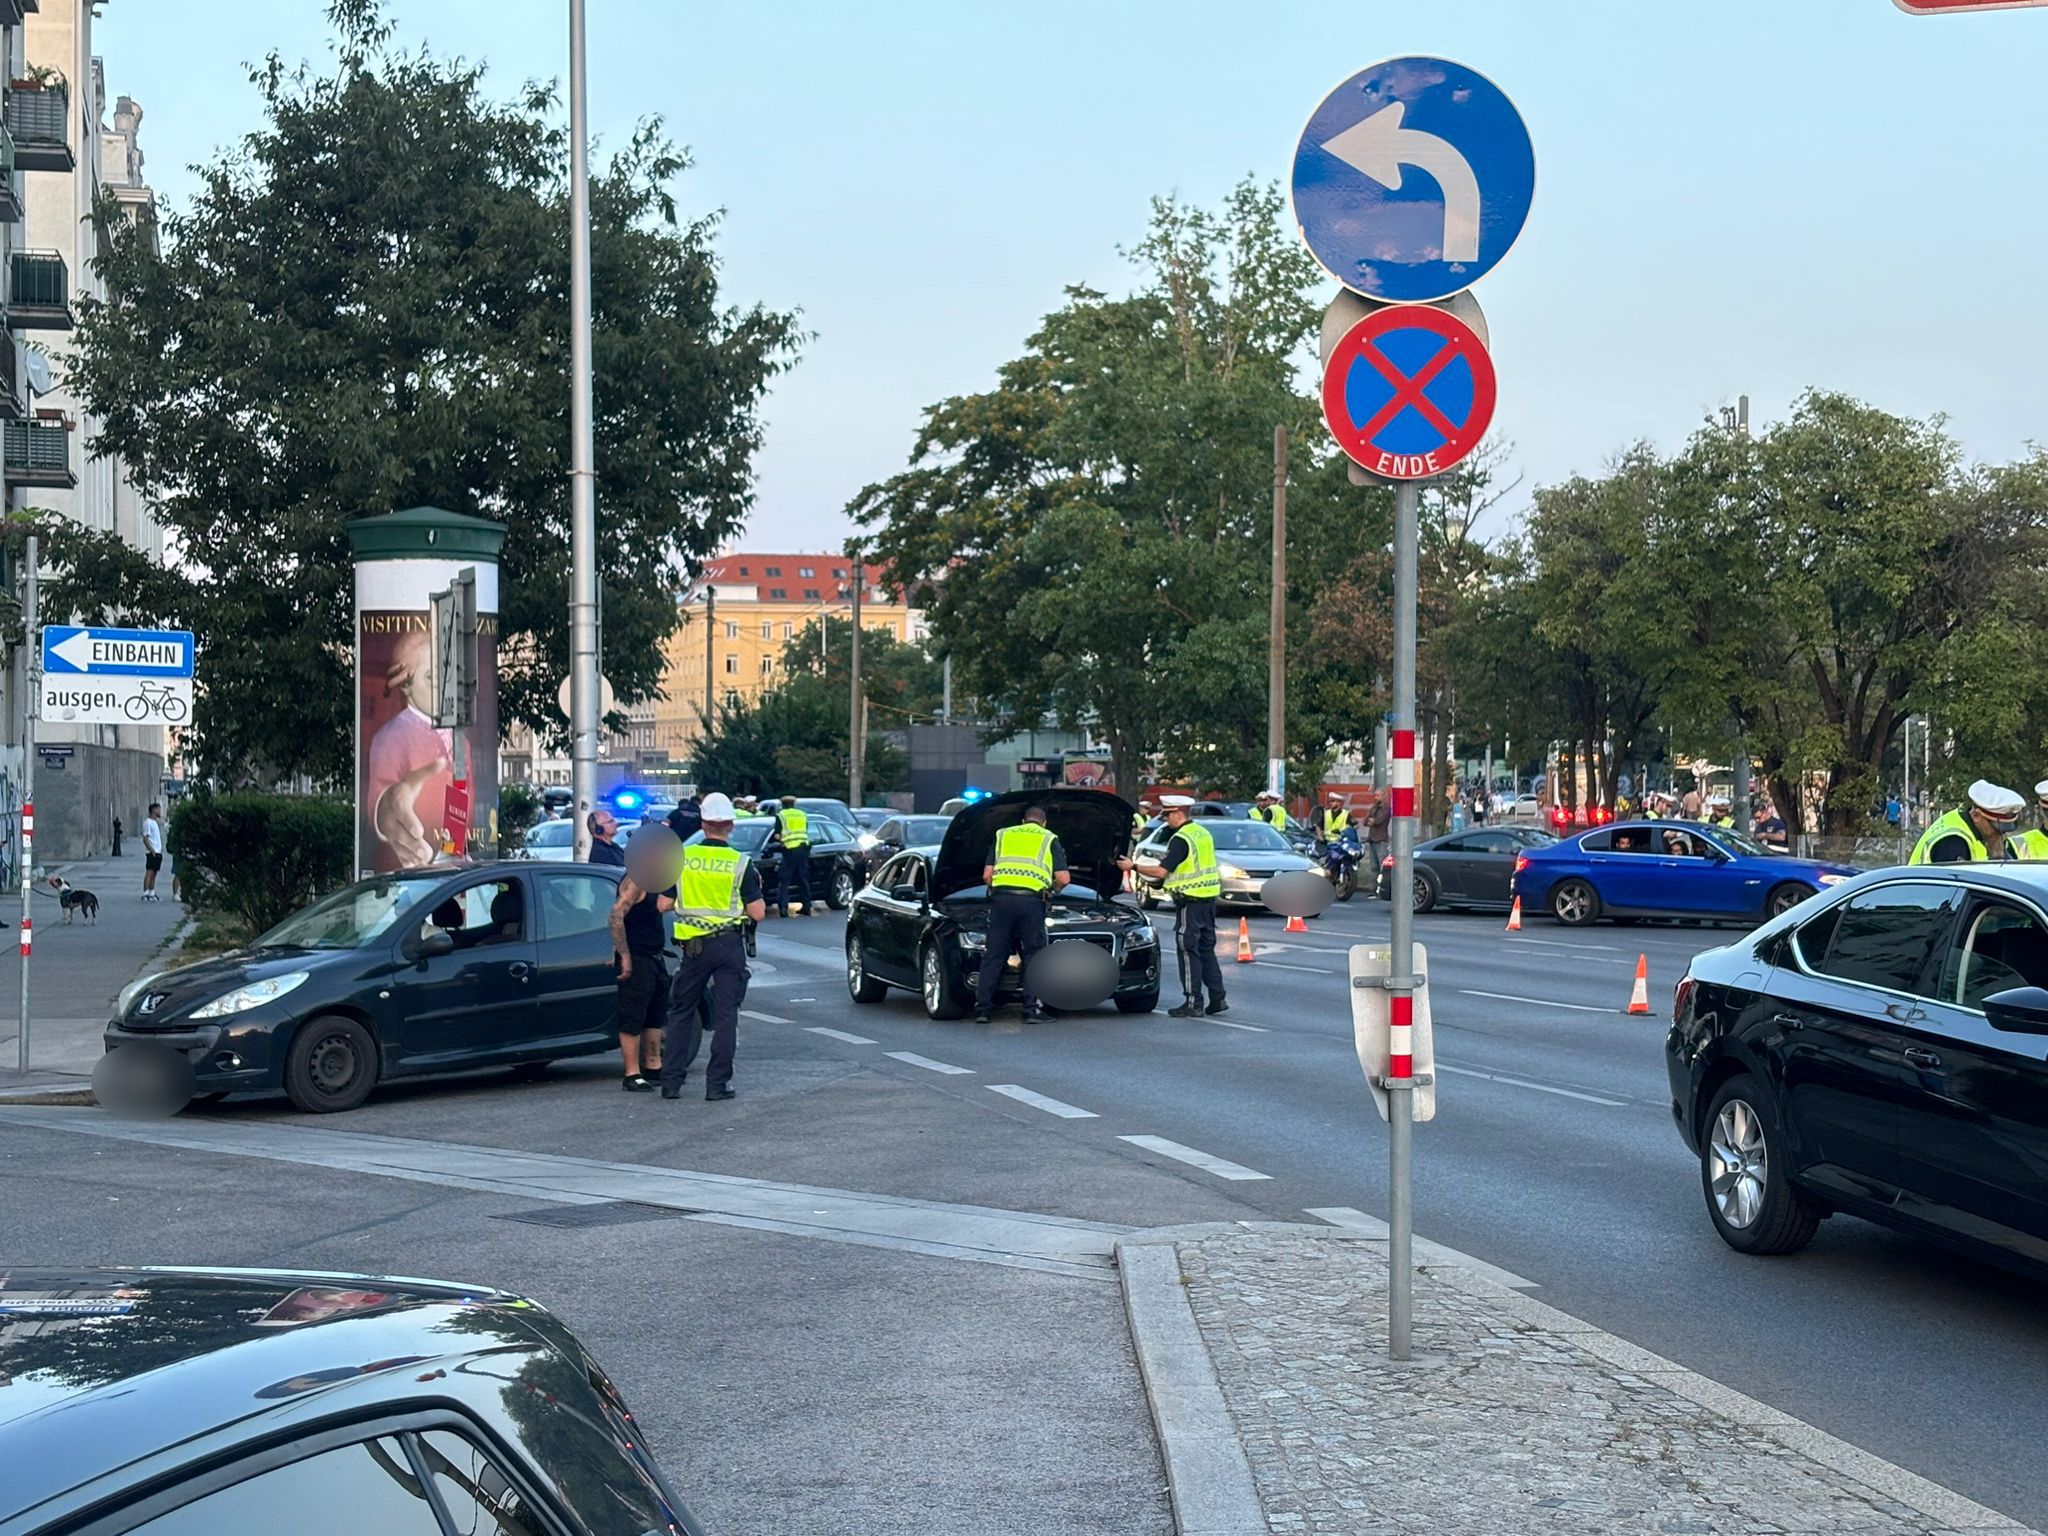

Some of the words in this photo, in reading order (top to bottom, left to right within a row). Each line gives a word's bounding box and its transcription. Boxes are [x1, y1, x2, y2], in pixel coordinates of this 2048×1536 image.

[1376, 451, 1440, 476] ENDE
[362, 615, 431, 634] VISITIN
[92, 642, 176, 664] EINBAHN
[47, 690, 122, 712] ausgen.
